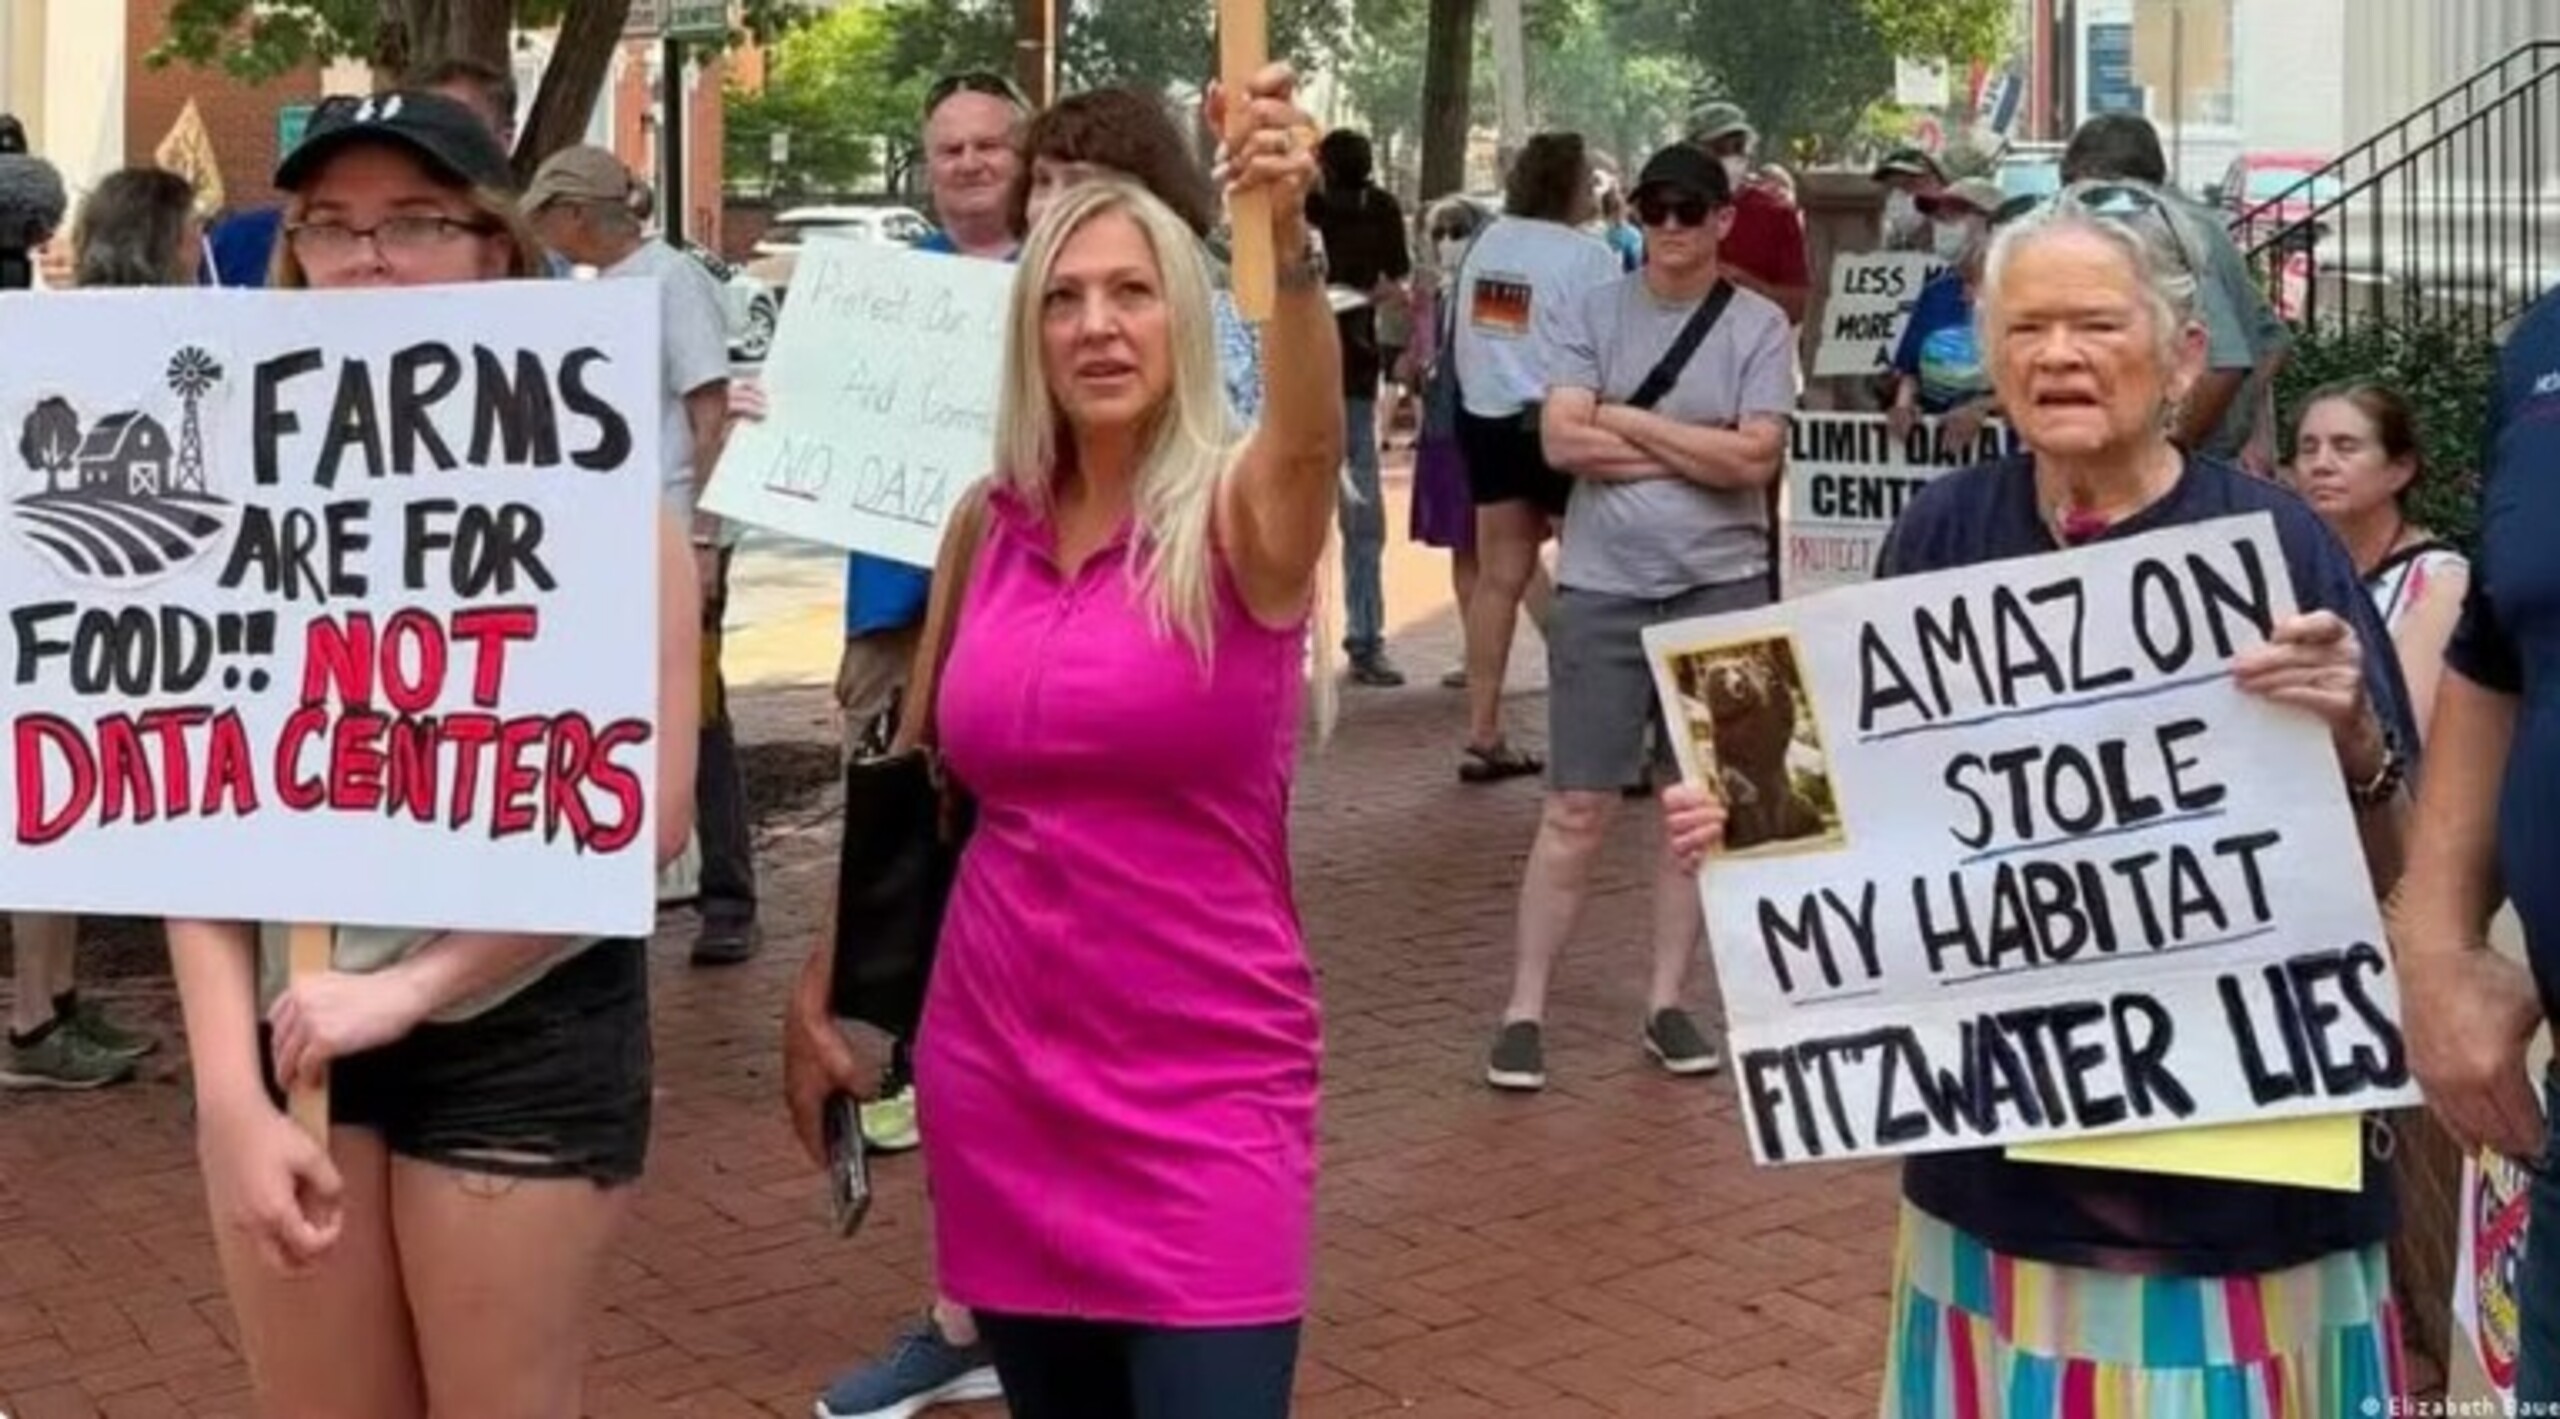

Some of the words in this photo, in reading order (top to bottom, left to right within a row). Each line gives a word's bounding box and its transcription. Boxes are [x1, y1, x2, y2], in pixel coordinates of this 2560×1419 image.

[1834, 312, 1896, 341] MORE
[1843, 266, 1906, 298] LESS
[253, 341, 633, 488] FARMS
[764, 436, 832, 492] NO
[1791, 420, 1889, 463] LIMIT
[217, 500, 371, 603] ARE
[402, 500, 557, 598] FOR
[10, 602, 276, 697] FOOD!!
[300, 604, 539, 712] NOT
[1857, 538, 2277, 731] AMAZON
[13, 705, 260, 845] DATA
[273, 702, 653, 855] CENTERS
[1942, 719, 2227, 850] STOLE
[1757, 880, 1882, 993] MY
[1912, 830, 2282, 973] HABITAT
[1740, 992, 2196, 1161] FITZWATER
[2216, 941, 2410, 1107] LIES
